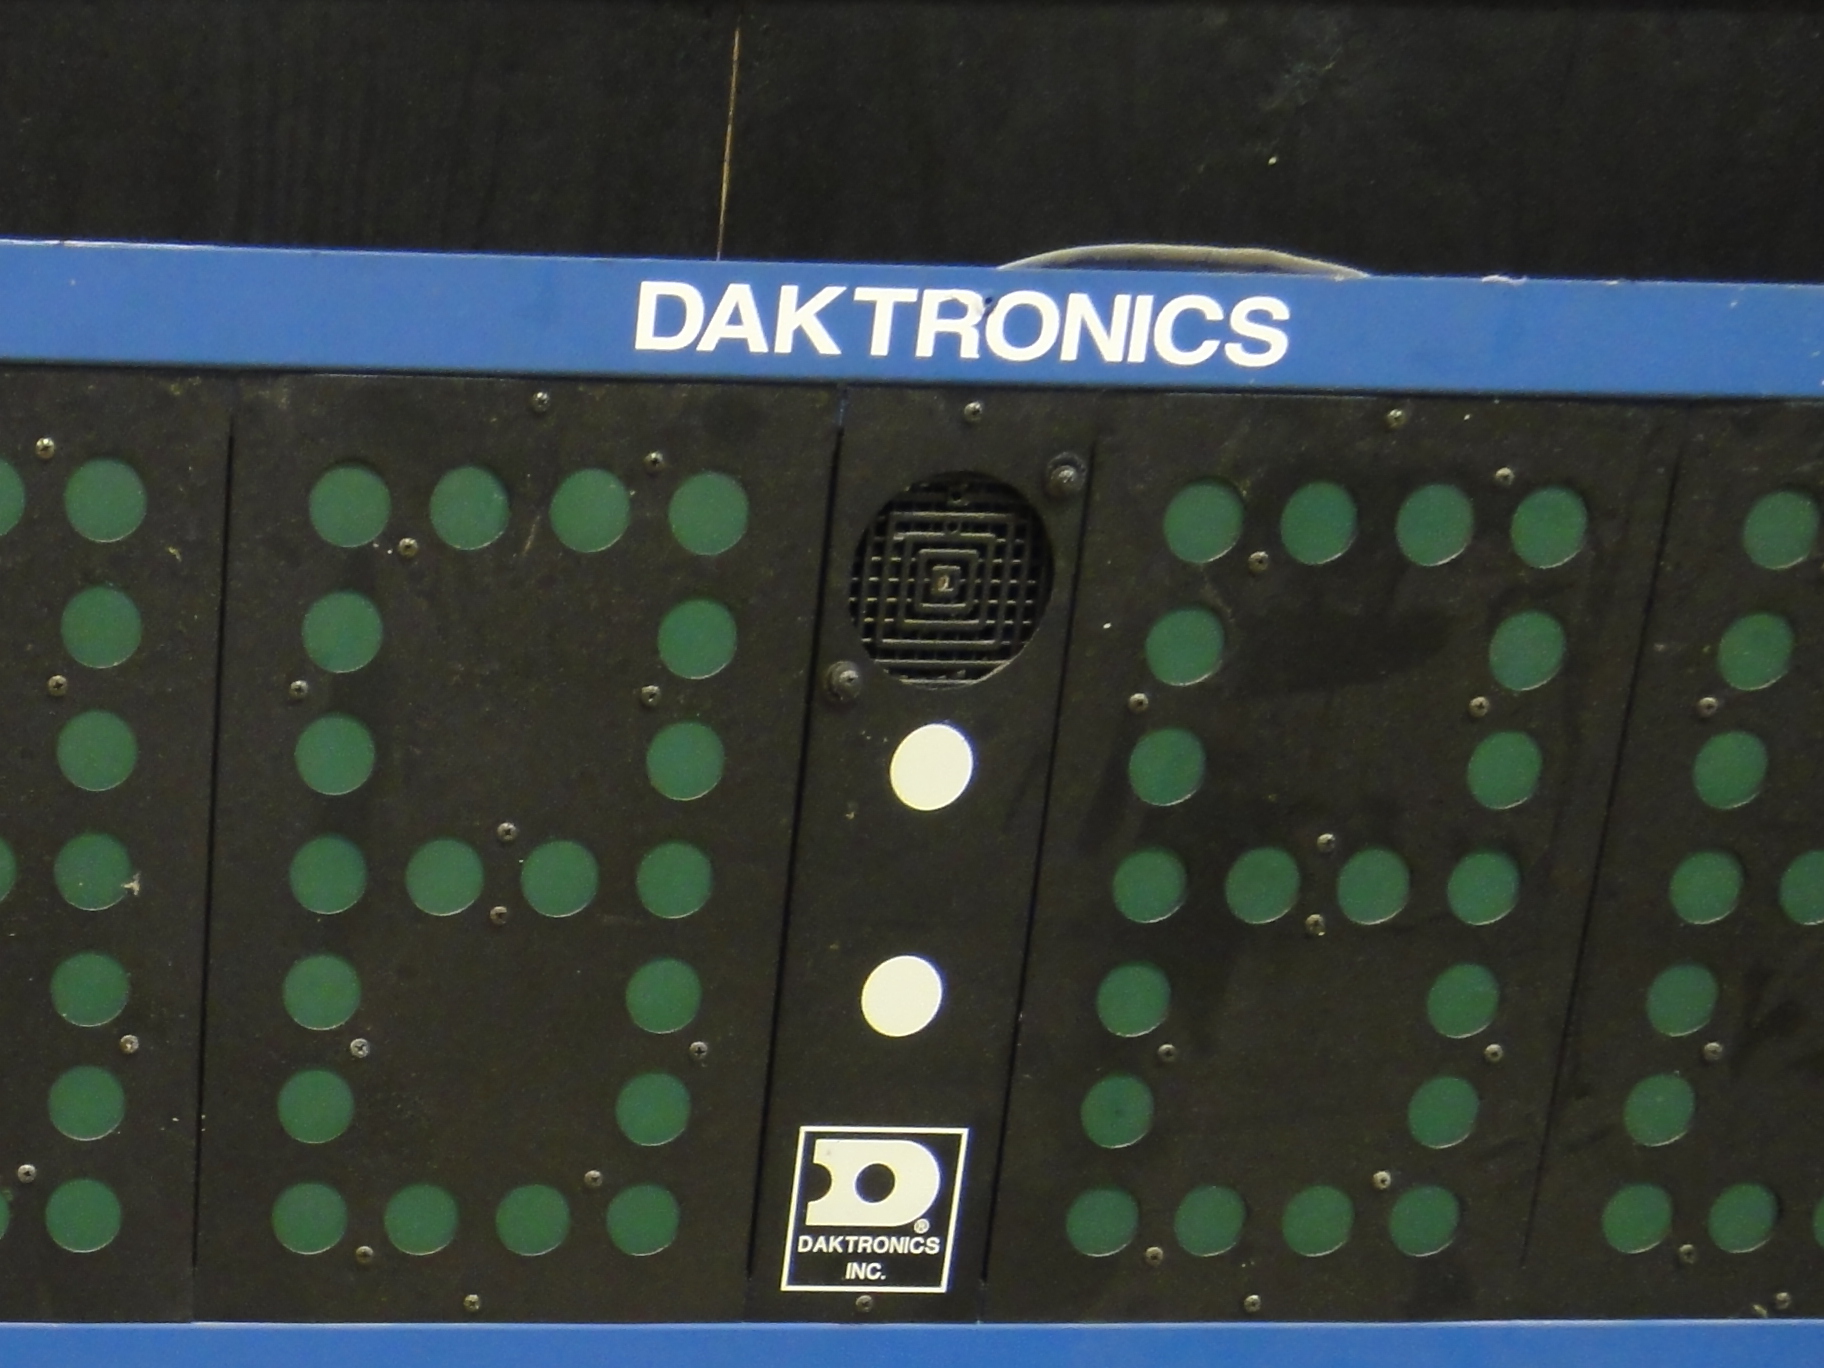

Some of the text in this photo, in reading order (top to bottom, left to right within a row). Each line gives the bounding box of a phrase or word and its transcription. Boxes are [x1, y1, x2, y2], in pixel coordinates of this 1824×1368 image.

[635, 280, 1290, 368] DAKTRONICS
[798, 1235, 940, 1254] DAKTRONICS
[845, 1262, 886, 1280] INC.
